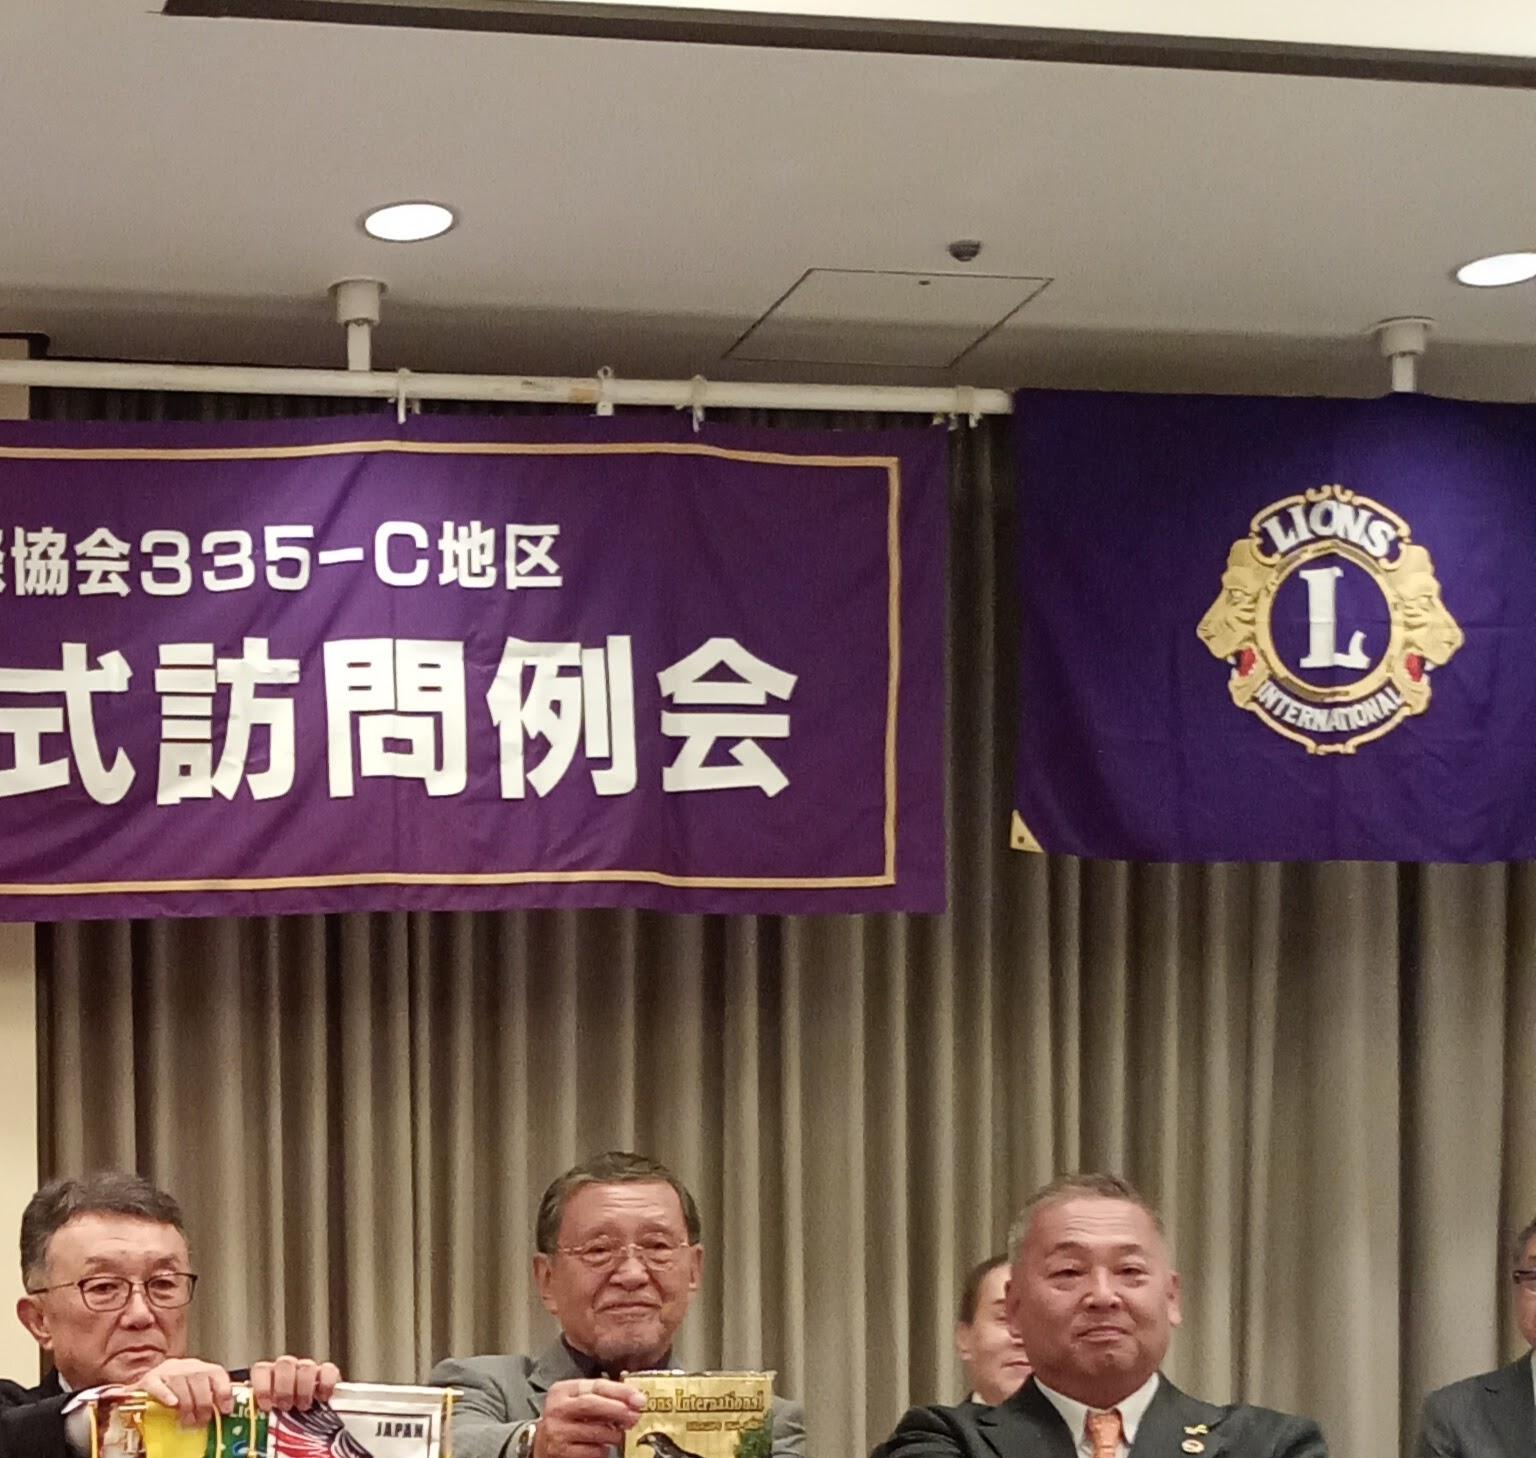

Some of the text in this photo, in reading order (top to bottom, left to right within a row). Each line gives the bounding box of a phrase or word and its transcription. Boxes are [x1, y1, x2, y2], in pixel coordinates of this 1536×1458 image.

[1262, 500, 1396, 558] LIONS
[1299, 567, 1370, 669] L
[1256, 680, 1403, 732] INTERNATIONAL
[375, 1421, 423, 1438] JAPAN
